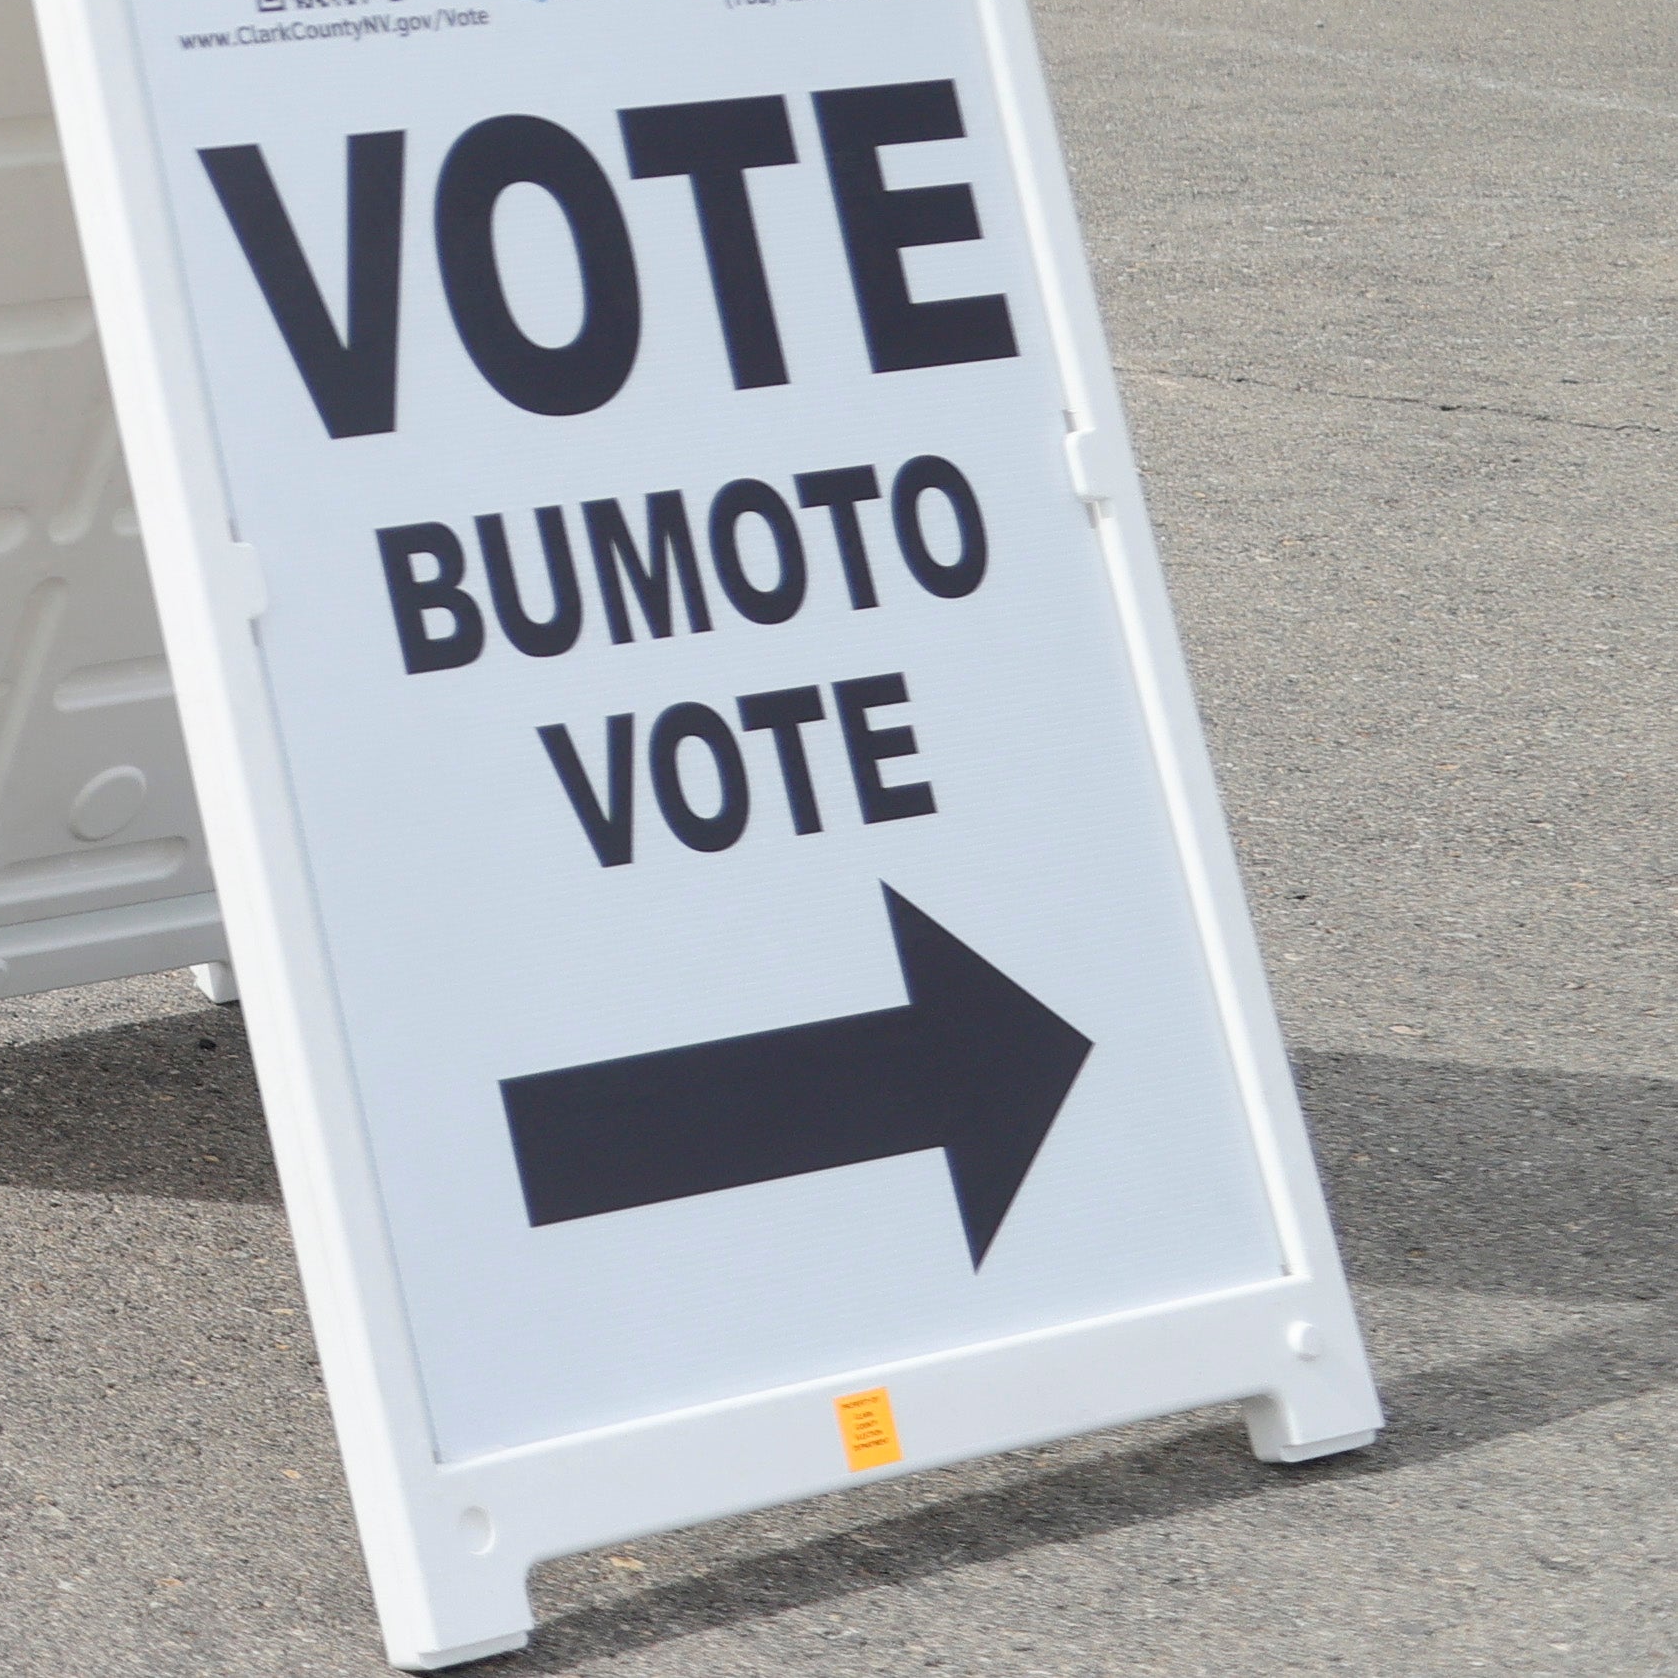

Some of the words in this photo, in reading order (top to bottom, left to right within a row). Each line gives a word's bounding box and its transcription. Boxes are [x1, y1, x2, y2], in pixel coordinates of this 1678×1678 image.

[179, 8, 490, 51] www.ClarkCountyNV.gov/Vote
[197, 78, 1020, 439] VOTE
[376, 453, 989, 675] BUMOTO
[535, 672, 938, 868] VOTE
